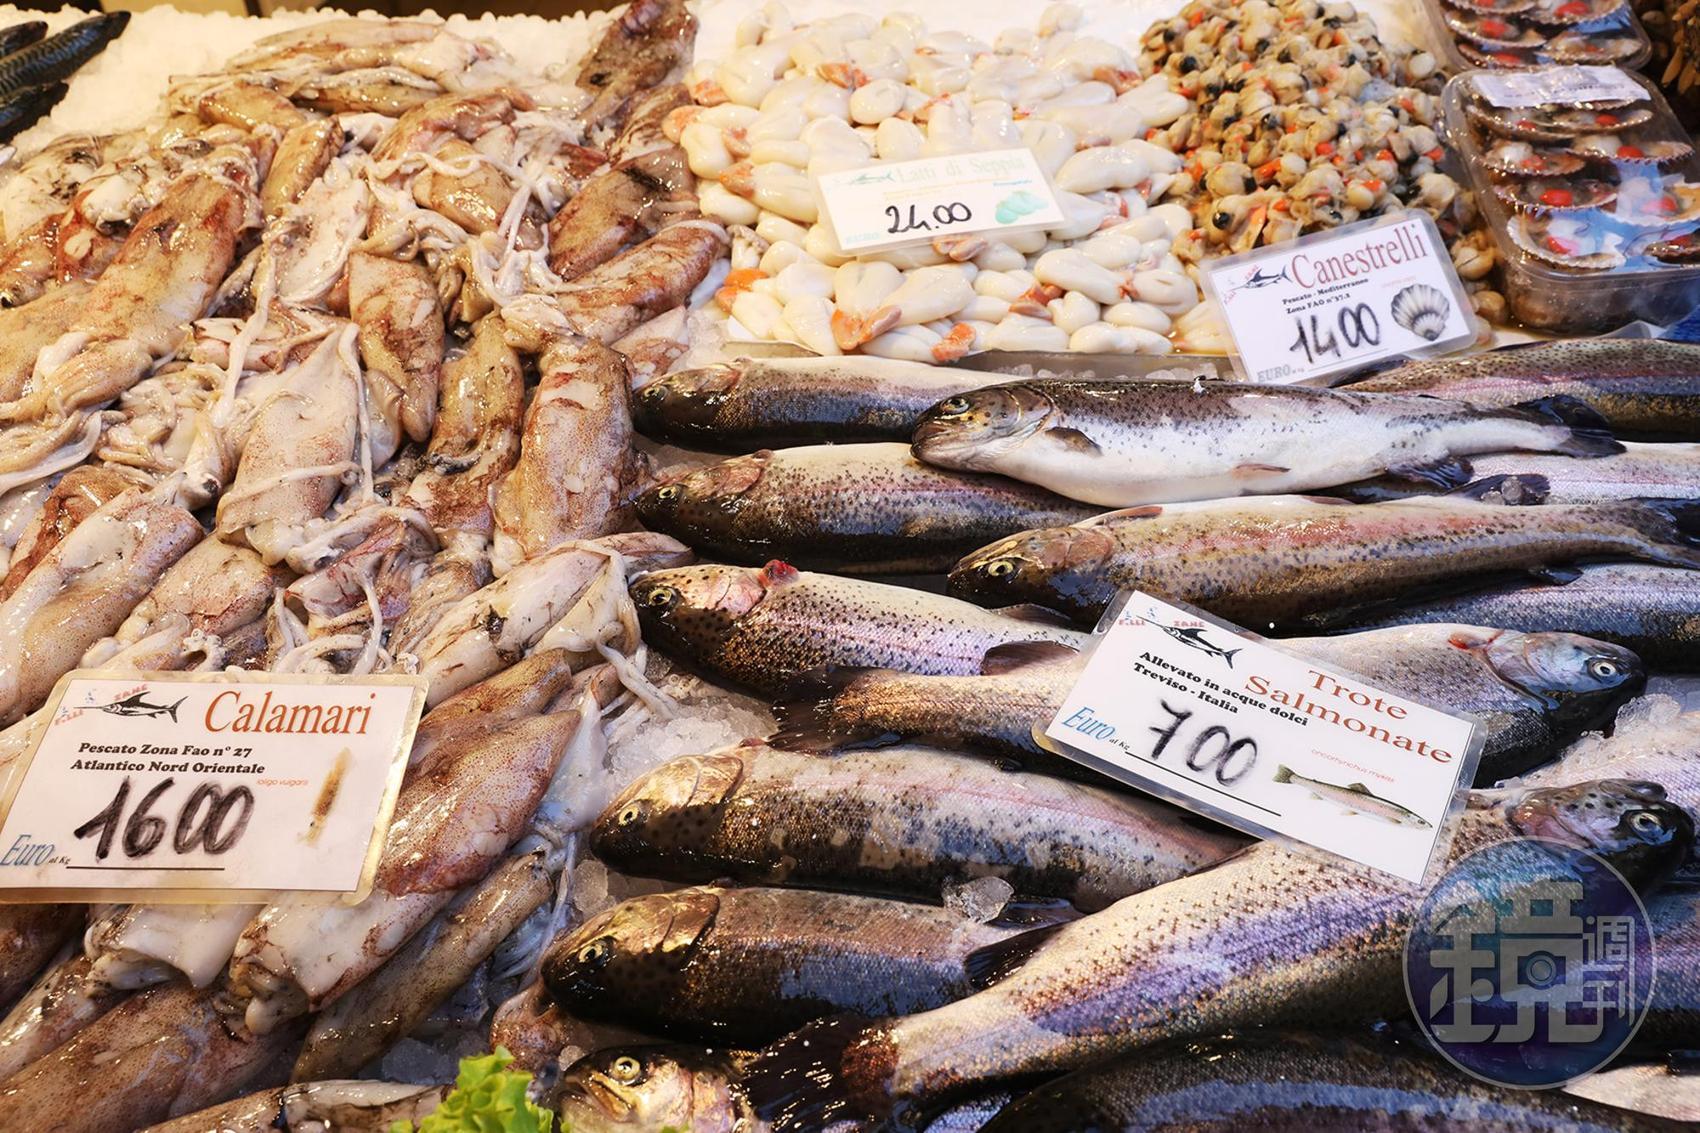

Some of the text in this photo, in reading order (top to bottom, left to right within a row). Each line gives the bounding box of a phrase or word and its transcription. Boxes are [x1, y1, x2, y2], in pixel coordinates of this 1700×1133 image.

[885, 202, 972, 234] 24.00
[1291, 223, 1428, 289] Canestrelli
[1307, 299, 1325, 309] FAO
[1133, 662, 1188, 693] Treviso
[1195, 690, 1239, 714] Italia
[1139, 651, 1309, 727] Allevato in acque dolci
[1307, 669, 1408, 720] Trote
[204, 690, 376, 735] Calamari
[1062, 705, 1116, 741] Euro
[1245, 675, 1453, 764] Salmonate
[70, 759, 265, 775] Atlantico Nord Orientale
[78, 743, 137, 755] Pescato
[140, 744, 178, 756] Zona
[181, 745, 210, 757] Fao
[233, 747, 253, 759] 27
[0, 834, 56, 867] Euro
